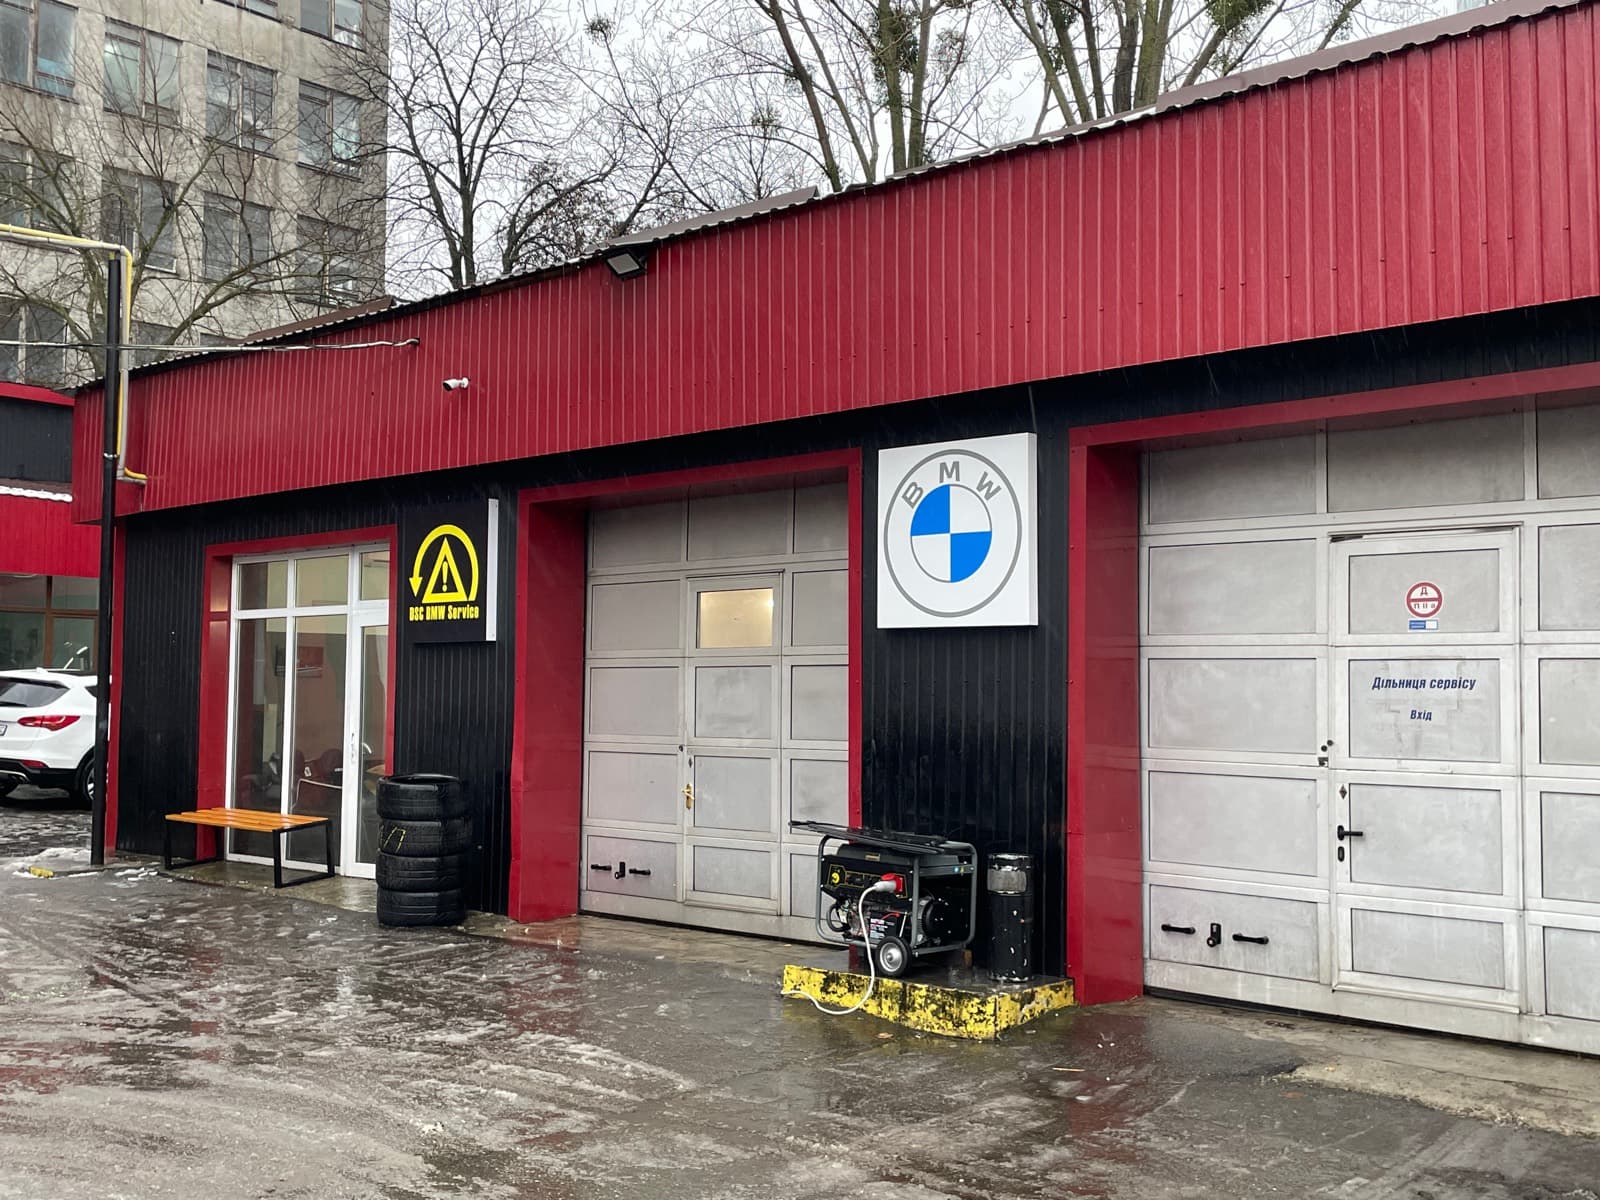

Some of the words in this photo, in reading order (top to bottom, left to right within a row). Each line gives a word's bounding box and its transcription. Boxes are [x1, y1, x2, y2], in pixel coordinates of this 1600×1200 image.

[901, 460, 1002, 509] BMW
[409, 606, 424, 621] DSC
[447, 604, 479, 620] Service
[1371, 677, 1426, 690] Дільниця
[1429, 676, 1476, 690] сервісу
[1410, 709, 1433, 721] Вхід
